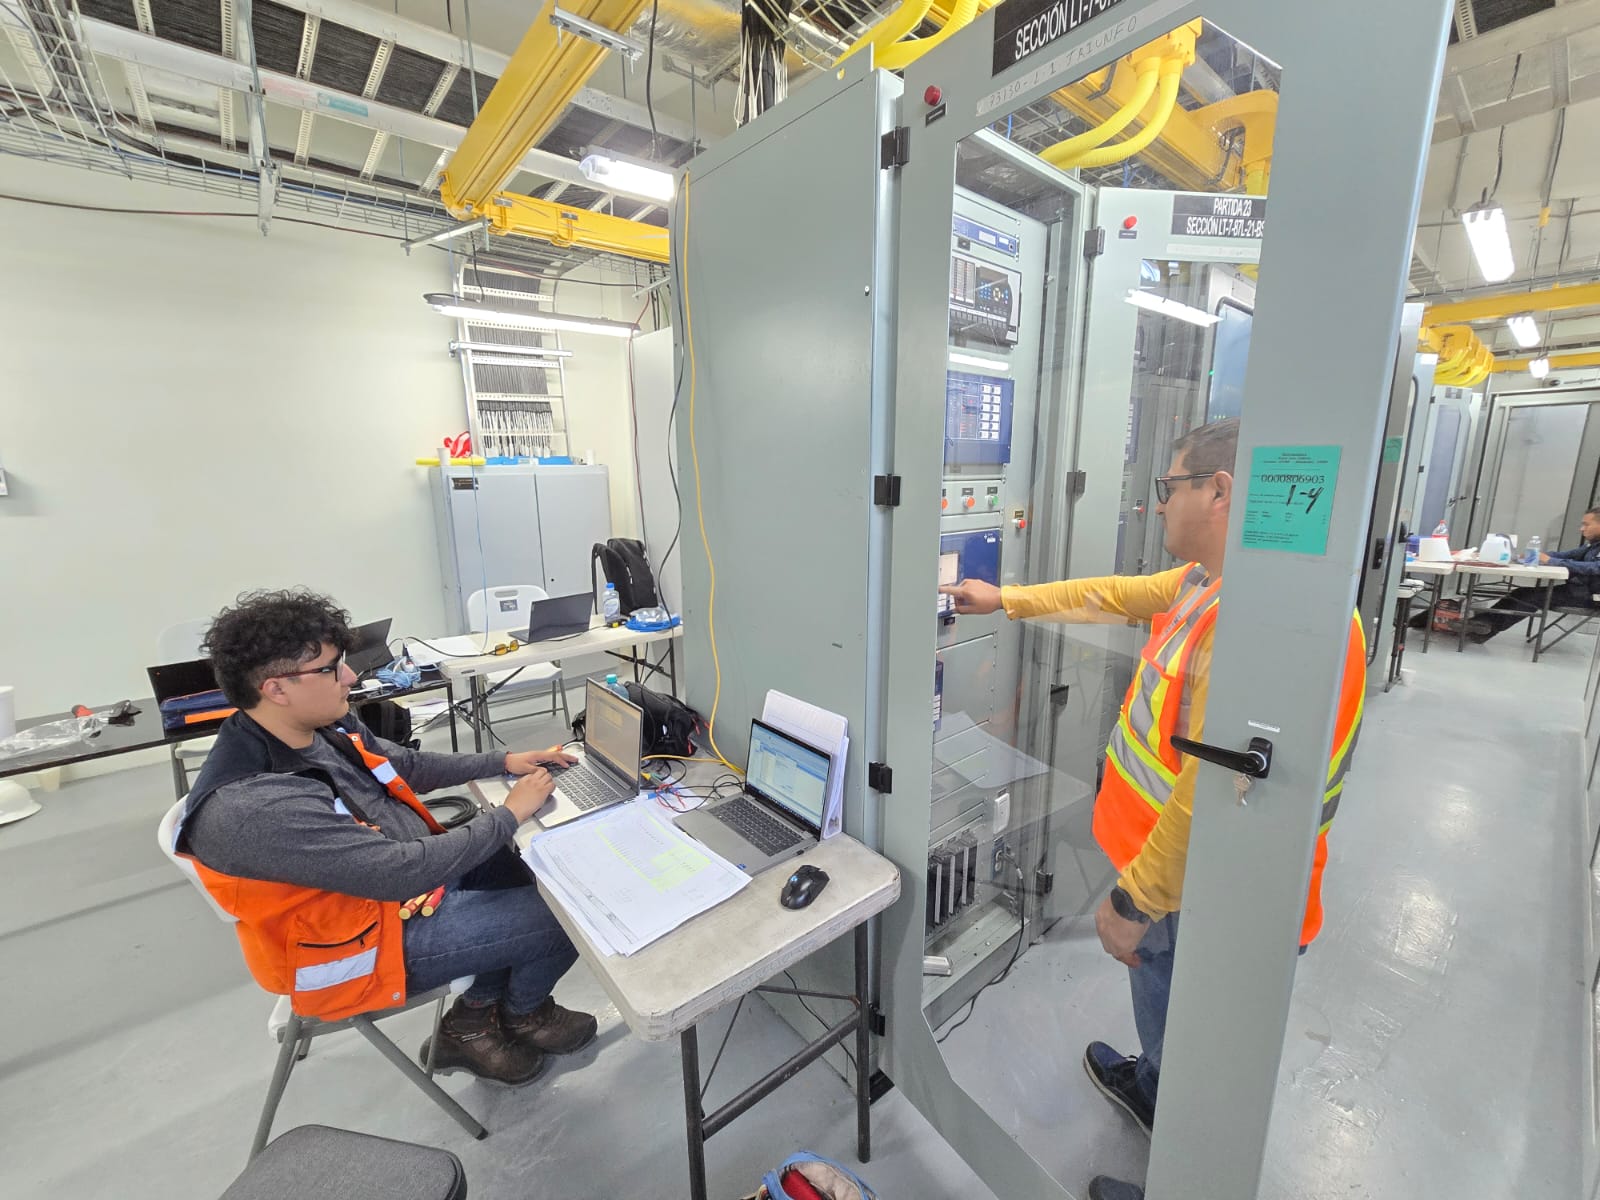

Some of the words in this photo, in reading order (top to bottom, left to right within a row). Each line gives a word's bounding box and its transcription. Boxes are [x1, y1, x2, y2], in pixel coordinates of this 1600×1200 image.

[1015, 0, 1067, 60] SECCIÓN
[1213, 197, 1243, 216] PARTIDA
[1242, 199, 1252, 216] 23
[1186, 215, 1218, 235] SECCIÓN
[1261, 474, 1325, 484] 0000806903
